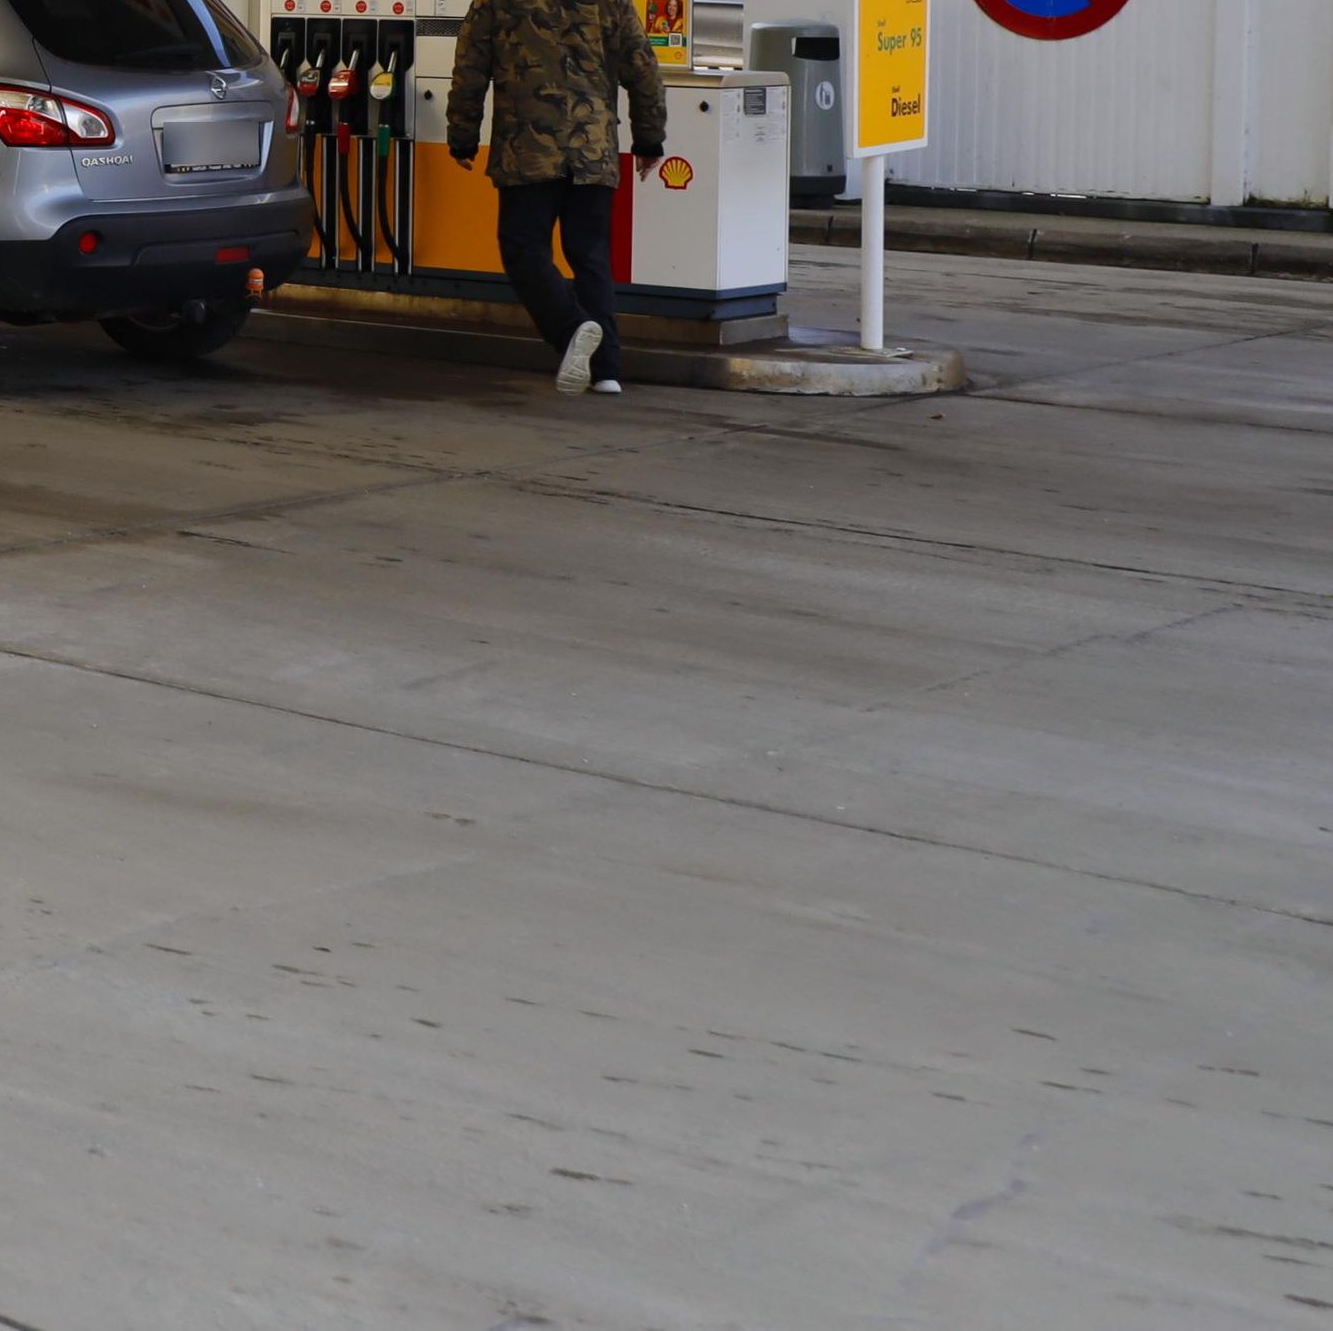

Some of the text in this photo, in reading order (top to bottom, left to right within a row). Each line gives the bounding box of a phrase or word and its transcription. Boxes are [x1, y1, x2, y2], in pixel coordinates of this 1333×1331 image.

[877, 27, 922, 55] Super 95
[891, 93, 920, 117] Diesel
[82, 155, 133, 167] QASHQAI
